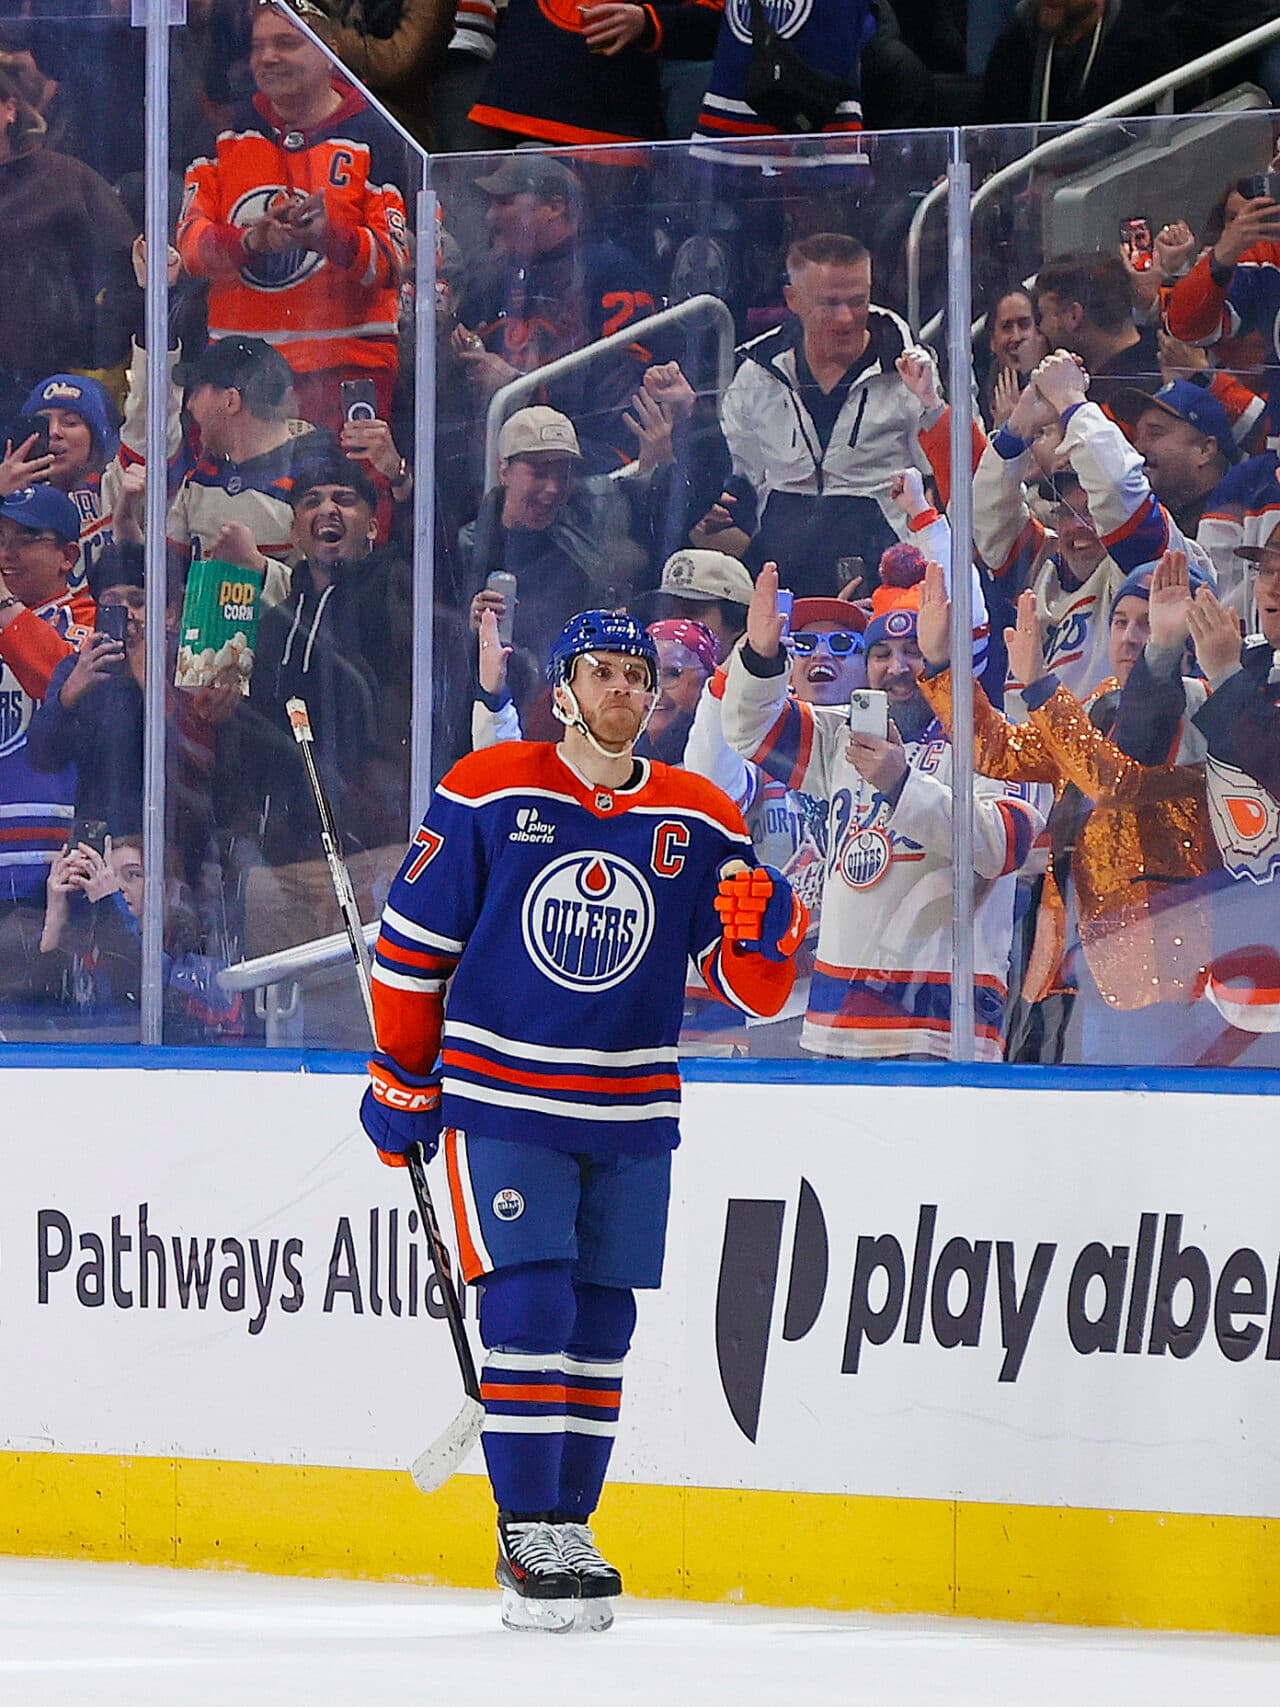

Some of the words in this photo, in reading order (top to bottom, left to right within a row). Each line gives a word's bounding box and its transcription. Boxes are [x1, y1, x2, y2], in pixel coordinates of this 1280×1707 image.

[328, 151, 352, 187] C
[220, 581, 255, 606] POP
[224, 604, 254, 621] CORN
[919, 738, 945, 775] C
[509, 831, 555, 844] alberta
[528, 821, 556, 834] play
[403, 824, 445, 884] 7
[650, 819, 690, 879] C
[847, 848, 882, 882] OILERS
[542, 898, 637, 974] OILERS
[372, 1076, 438, 1110] CCM
[38, 1203, 305, 1336] Pathways
[841, 1204, 1058, 1383] play
